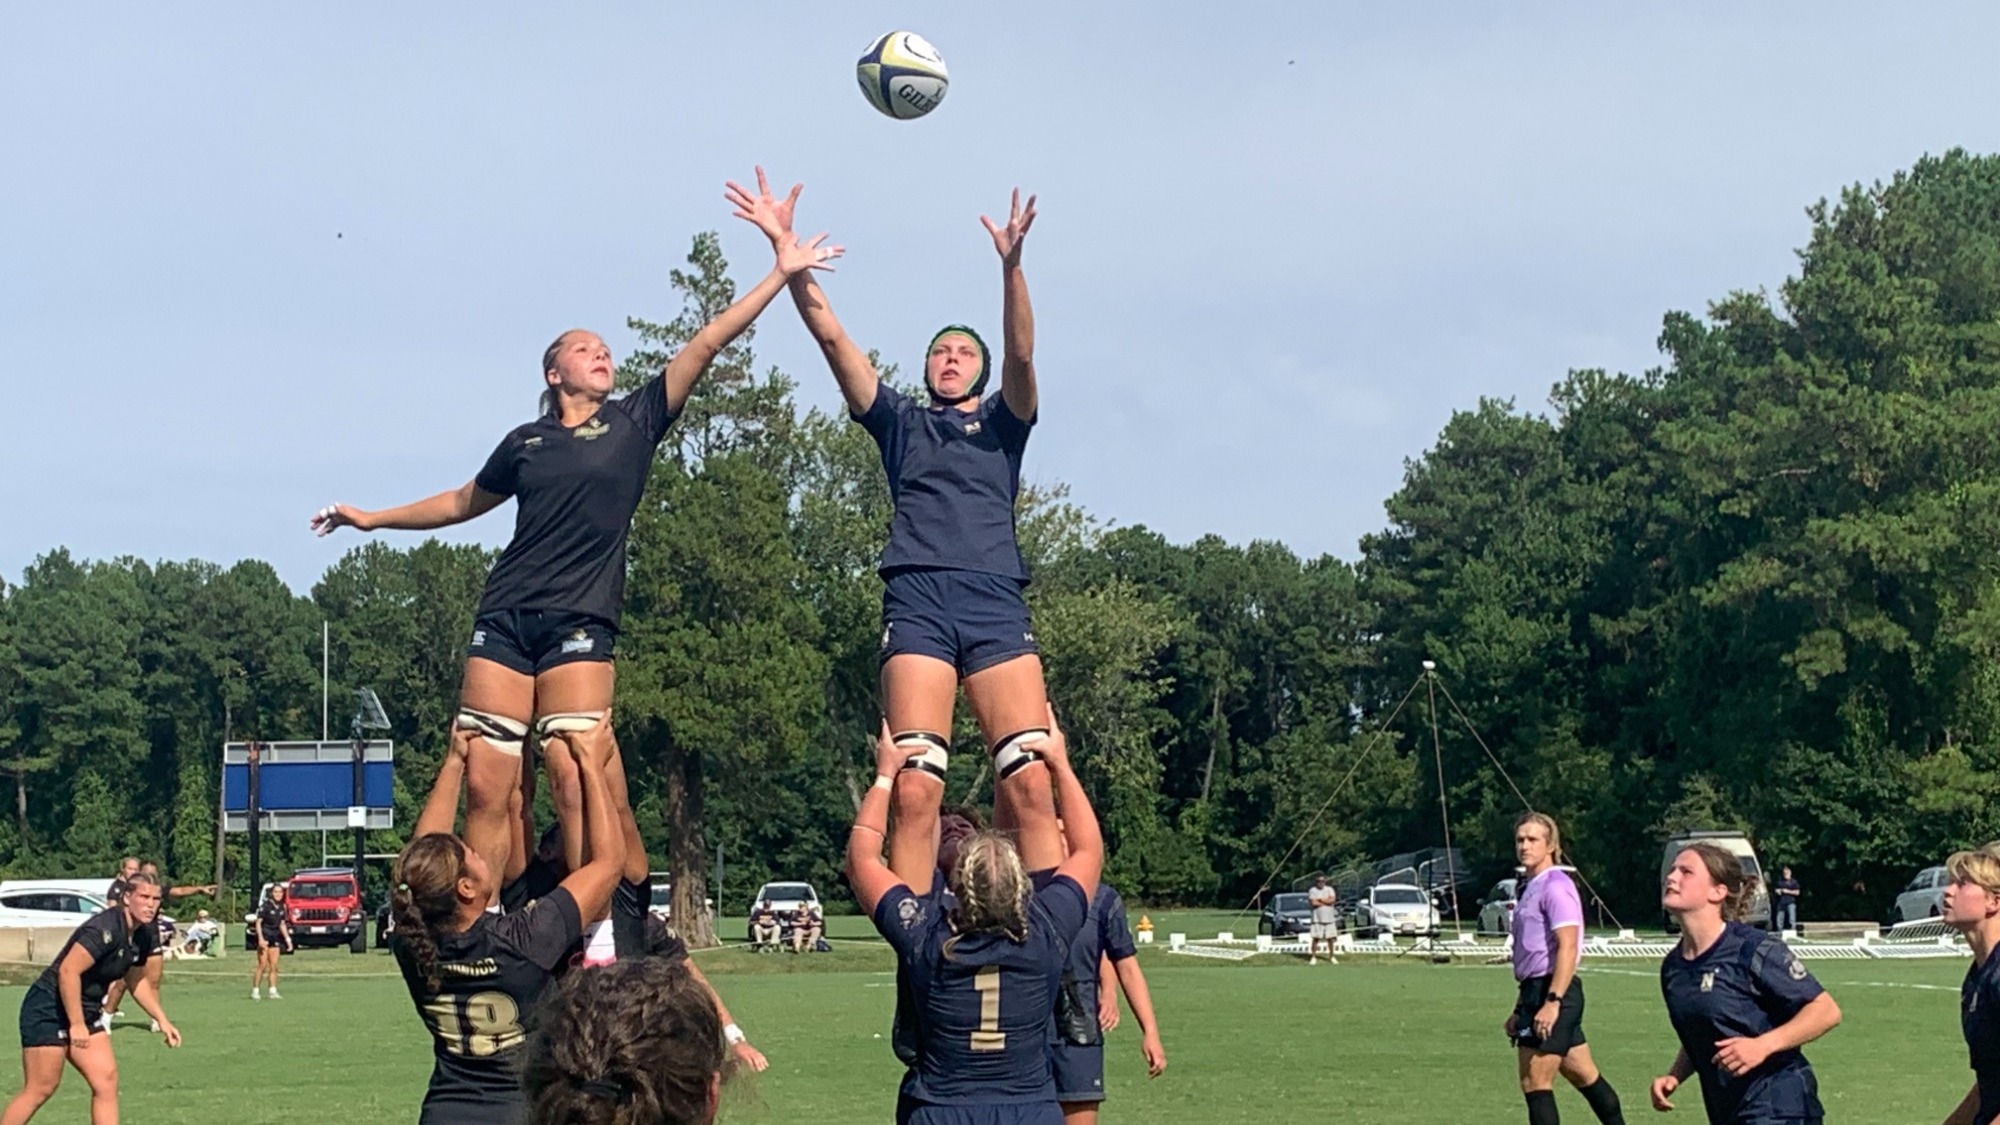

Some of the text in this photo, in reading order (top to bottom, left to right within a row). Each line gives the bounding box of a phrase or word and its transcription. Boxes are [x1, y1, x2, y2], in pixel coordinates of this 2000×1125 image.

[970, 965, 1006, 1051] 1
[1701, 972, 1715, 993] N
[424, 991, 526, 1056] 18
